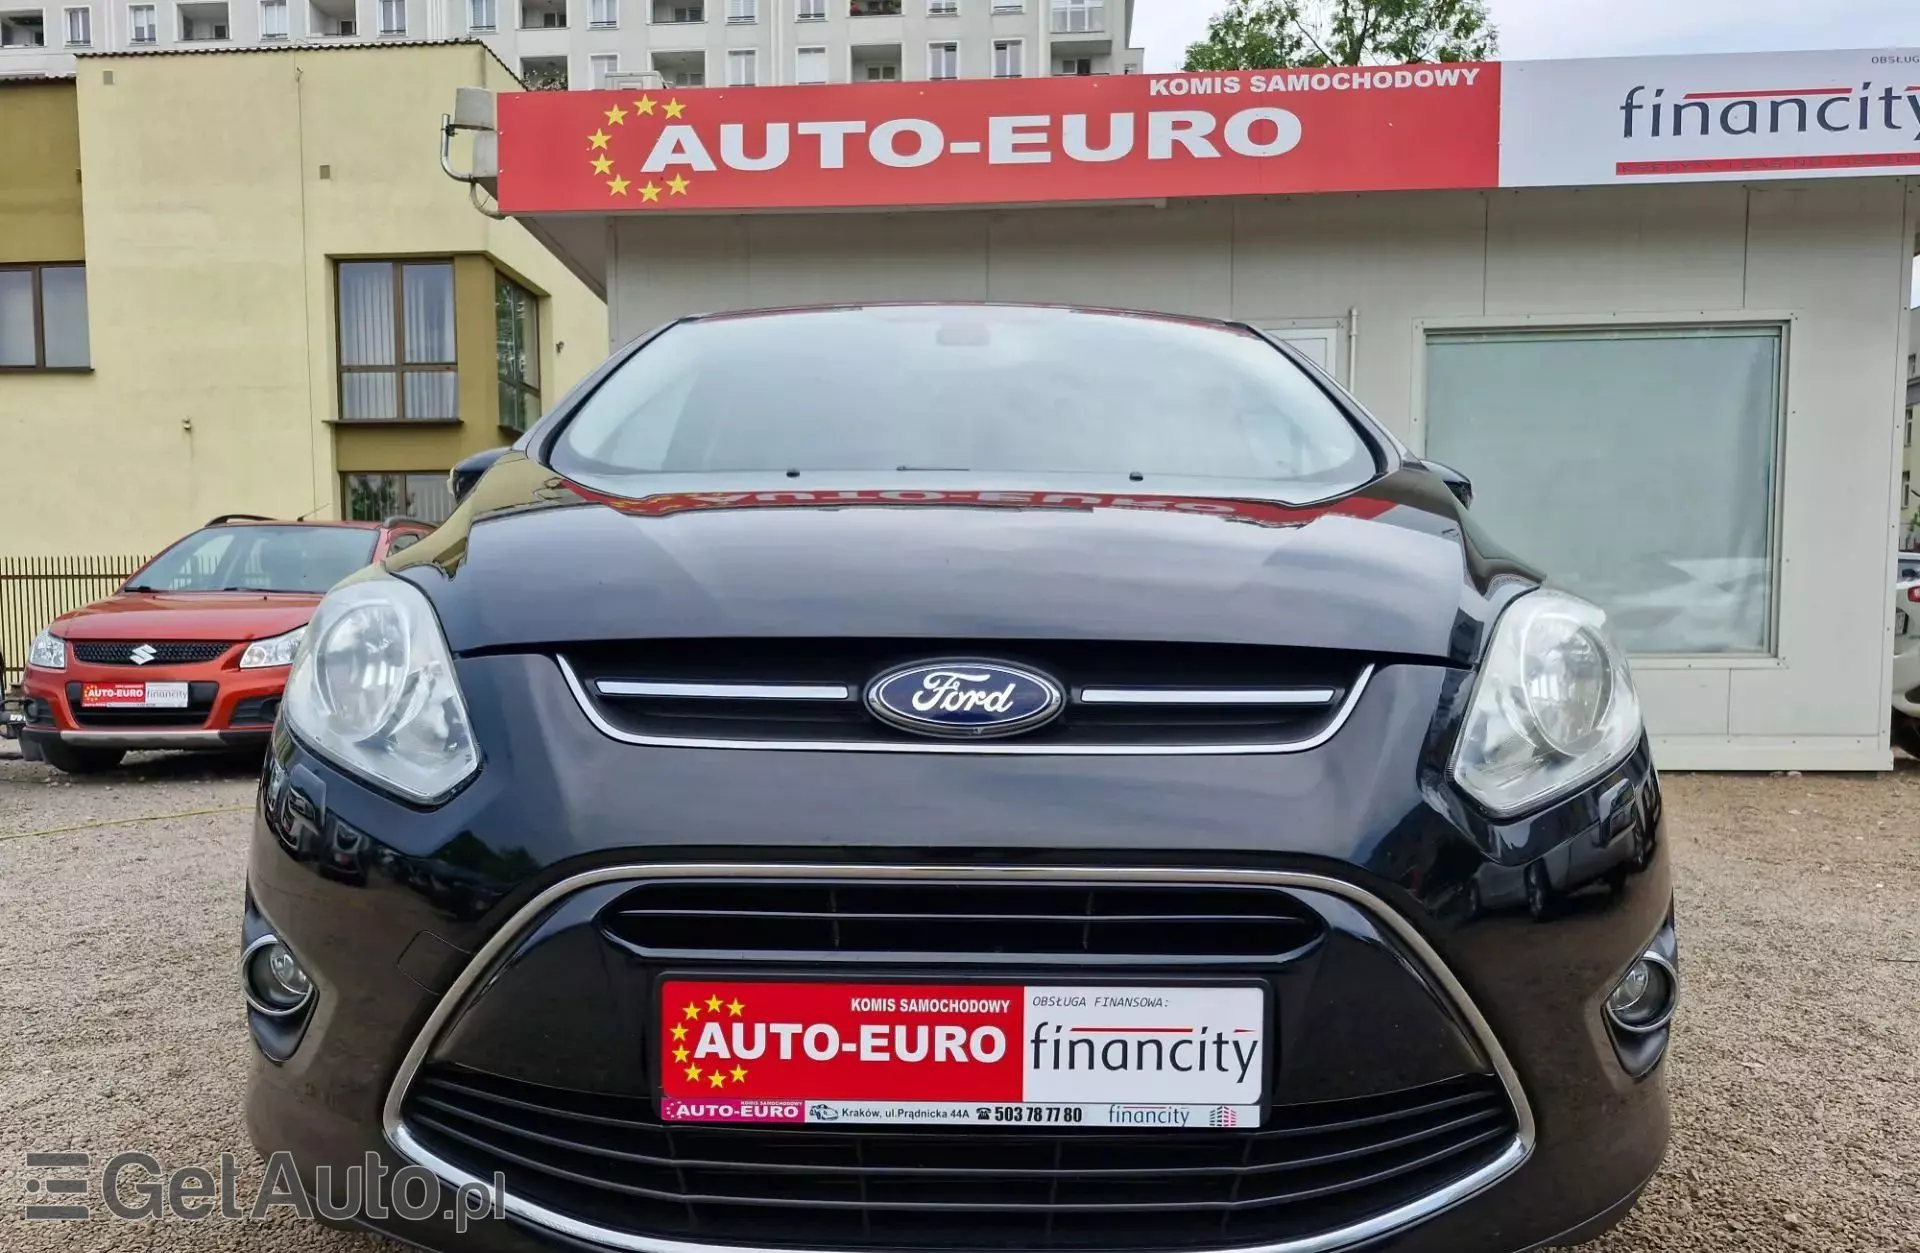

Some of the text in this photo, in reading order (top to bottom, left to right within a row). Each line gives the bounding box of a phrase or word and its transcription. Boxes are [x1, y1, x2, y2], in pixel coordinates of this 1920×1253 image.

[1149, 65, 1481, 98] KOMIS SAMOCHODOWY
[640, 106, 1303, 173] AUTO-EURO
[88, 688, 144, 698] AUTO-EURO
[912, 671, 1017, 713] Ford
[850, 997, 1010, 1014] KOMIS SAMOCHODOWY
[1032, 995, 1170, 1009] OBSŁUGA FINANSOWA:
[693, 1021, 1007, 1064] AUTO-EURO
[1031, 1021, 1259, 1084] financity
[676, 1104, 800, 1119] AUTO-EURO
[842, 1107, 883, 1120] Kraków,
[950, 1108, 970, 1119] 44A
[994, 1107, 1023, 1123] 503
[1026, 1107, 1043, 1123] 78
[1045, 1107, 1061, 1123] 77
[1063, 1107, 1083, 1123] 80
[1108, 1104, 1191, 1127] financity
